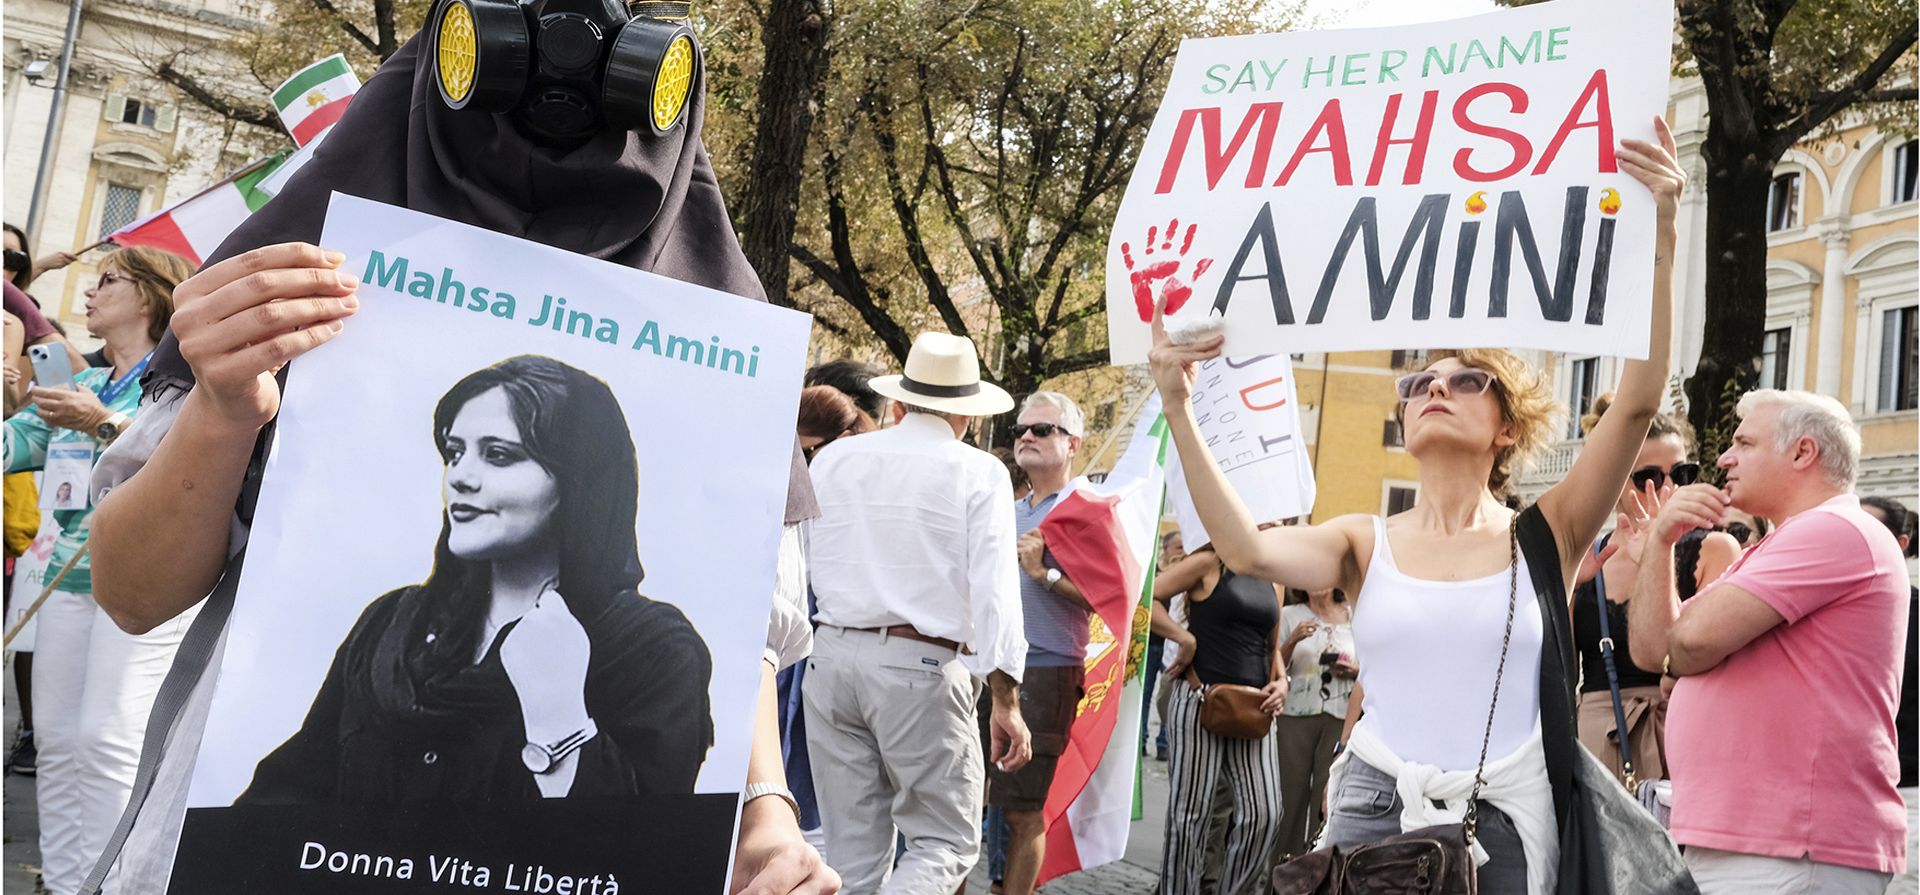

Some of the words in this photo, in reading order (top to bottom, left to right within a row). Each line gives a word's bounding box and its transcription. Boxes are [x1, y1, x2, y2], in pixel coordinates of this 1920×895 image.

[1201, 58, 1288, 95] SAY
[1301, 49, 1408, 89] HER
[1420, 26, 1571, 79] NAME
[1154, 68, 1619, 195] MAHSA
[362, 250, 518, 320] Mahsa
[528, 294, 620, 345] Jina
[632, 320, 761, 378] Amini
[1191, 390, 1231, 466] ONNE
[299, 841, 414, 880] Donna
[429, 855, 491, 888] Vita
[504, 863, 620, 895] Libertà
